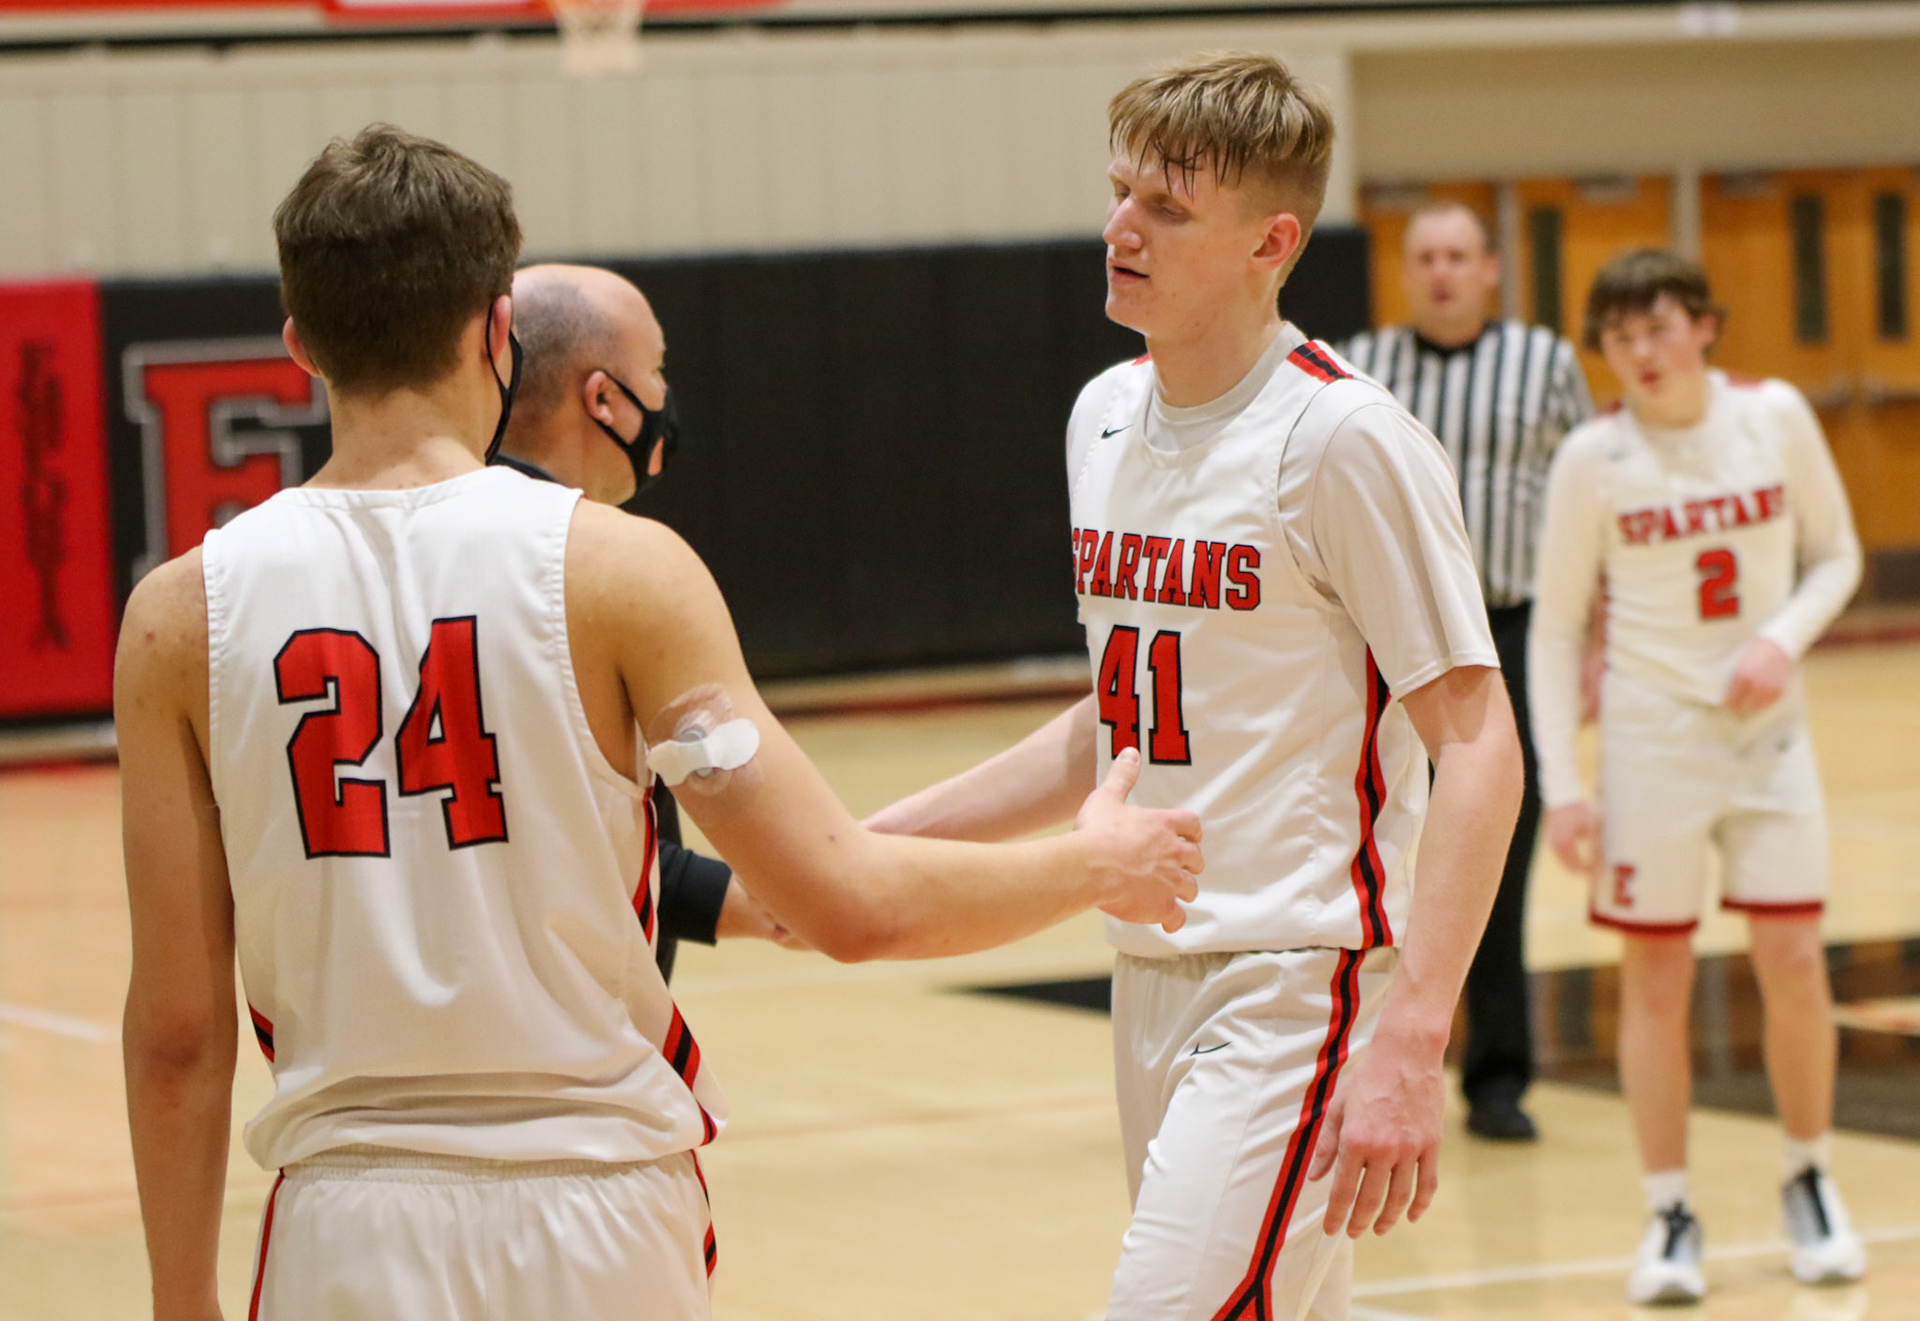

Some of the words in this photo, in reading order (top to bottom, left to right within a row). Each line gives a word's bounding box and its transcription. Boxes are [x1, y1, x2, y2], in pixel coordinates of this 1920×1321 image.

[1693, 547, 1741, 622] 2
[273, 615, 509, 860] 24
[1097, 624, 1192, 766] 41
